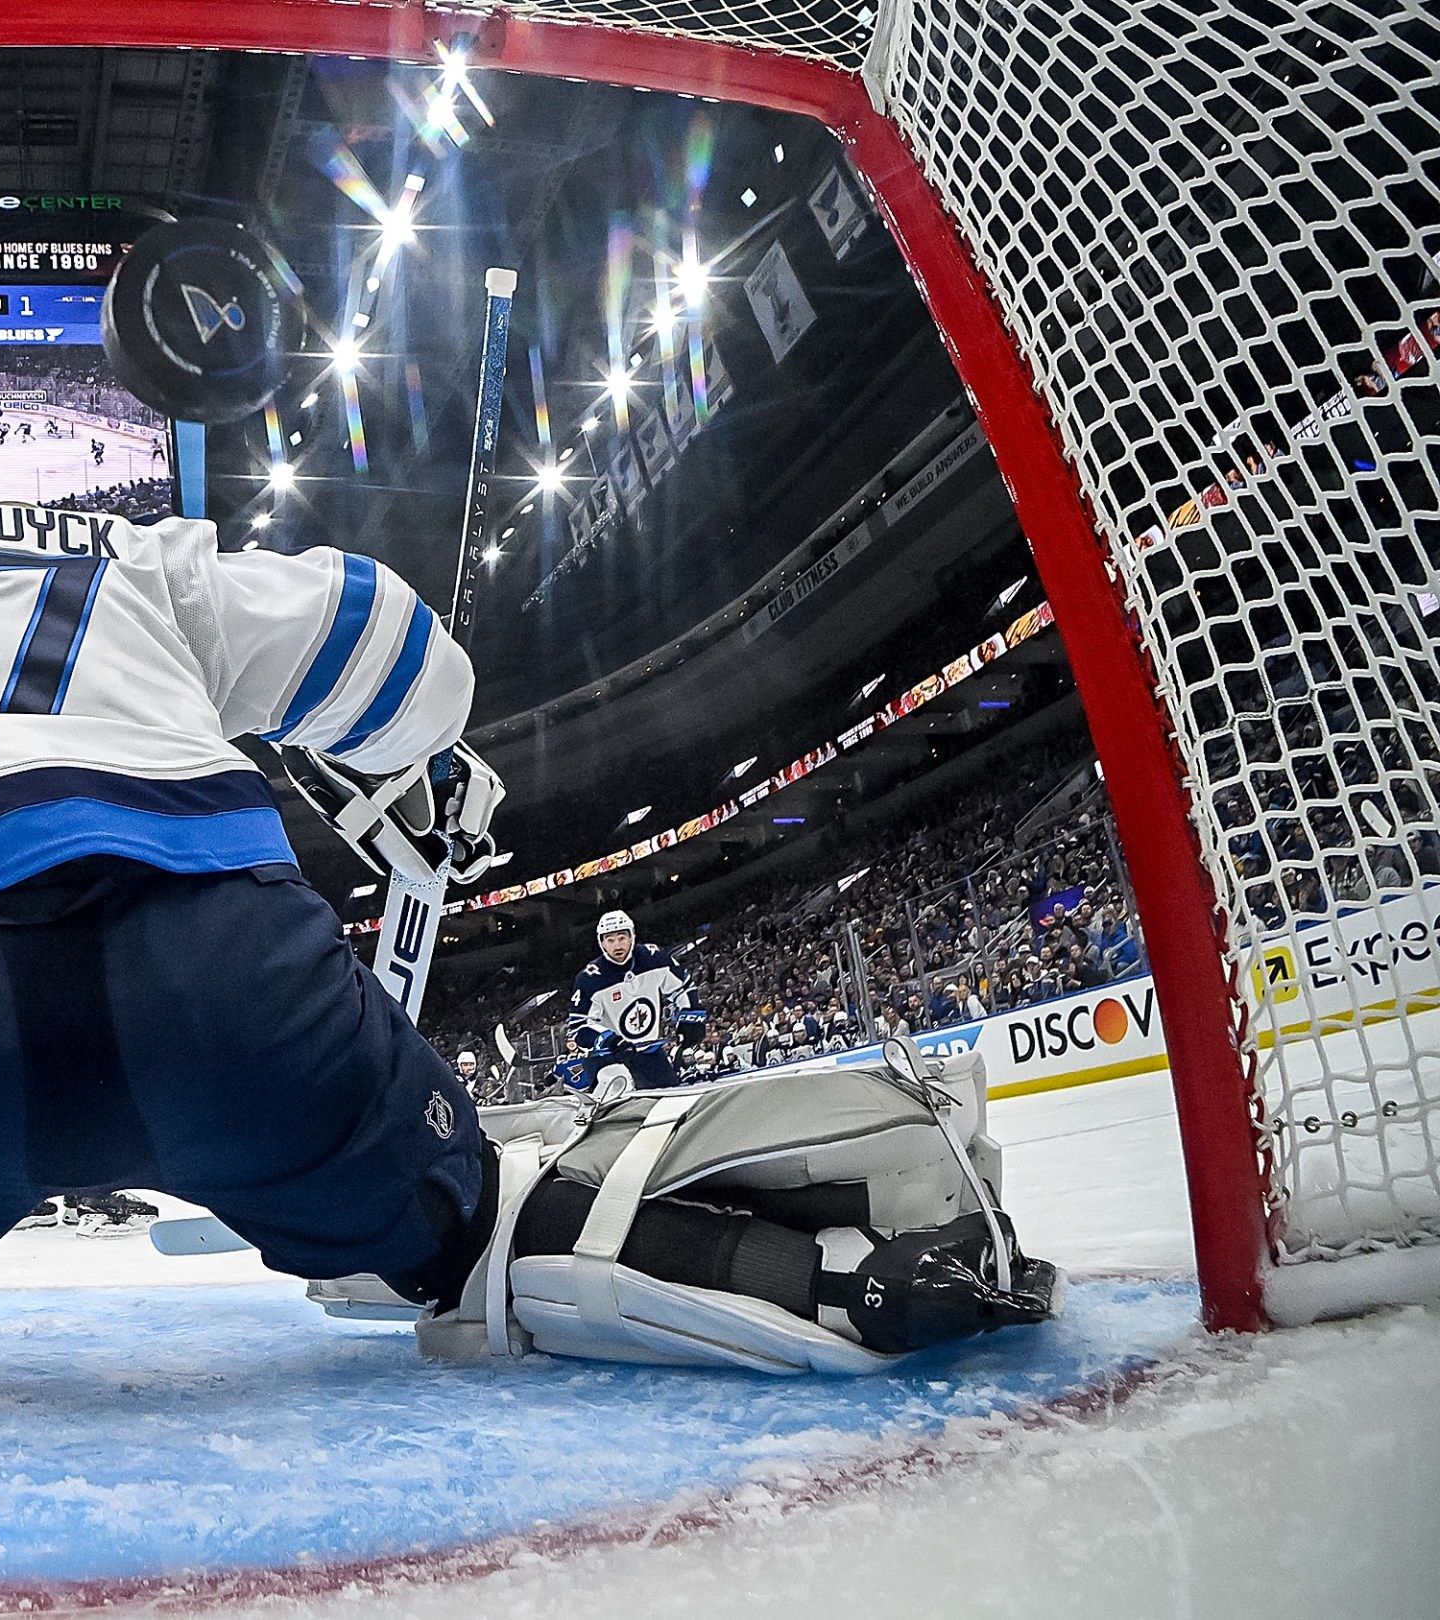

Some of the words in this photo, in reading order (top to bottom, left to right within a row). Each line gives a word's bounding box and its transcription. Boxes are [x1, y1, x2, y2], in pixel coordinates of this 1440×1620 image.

[23, 195, 123, 210] CENTER
[3, 242, 35, 255] HOME
[36, 242, 49, 255] OF
[50, 242, 84, 255] BLUES
[85, 243, 112, 255] FANS
[50, 254, 98, 270] 1990
[20, 296, 34, 316] 1
[3, 401, 39, 411] GEICO
[894, 494, 909, 511] WE
[909, 471, 935, 499] BUILD
[935, 432, 978, 476] ANSWERS
[460, 462, 489, 626] CATALYST
[767, 586, 796, 621] CLUB
[796, 551, 840, 598] FITNESS
[1305, 914, 1440, 988] Expe
[1009, 987, 1155, 1064] DISCOV
[864, 1276, 885, 1308] 37
